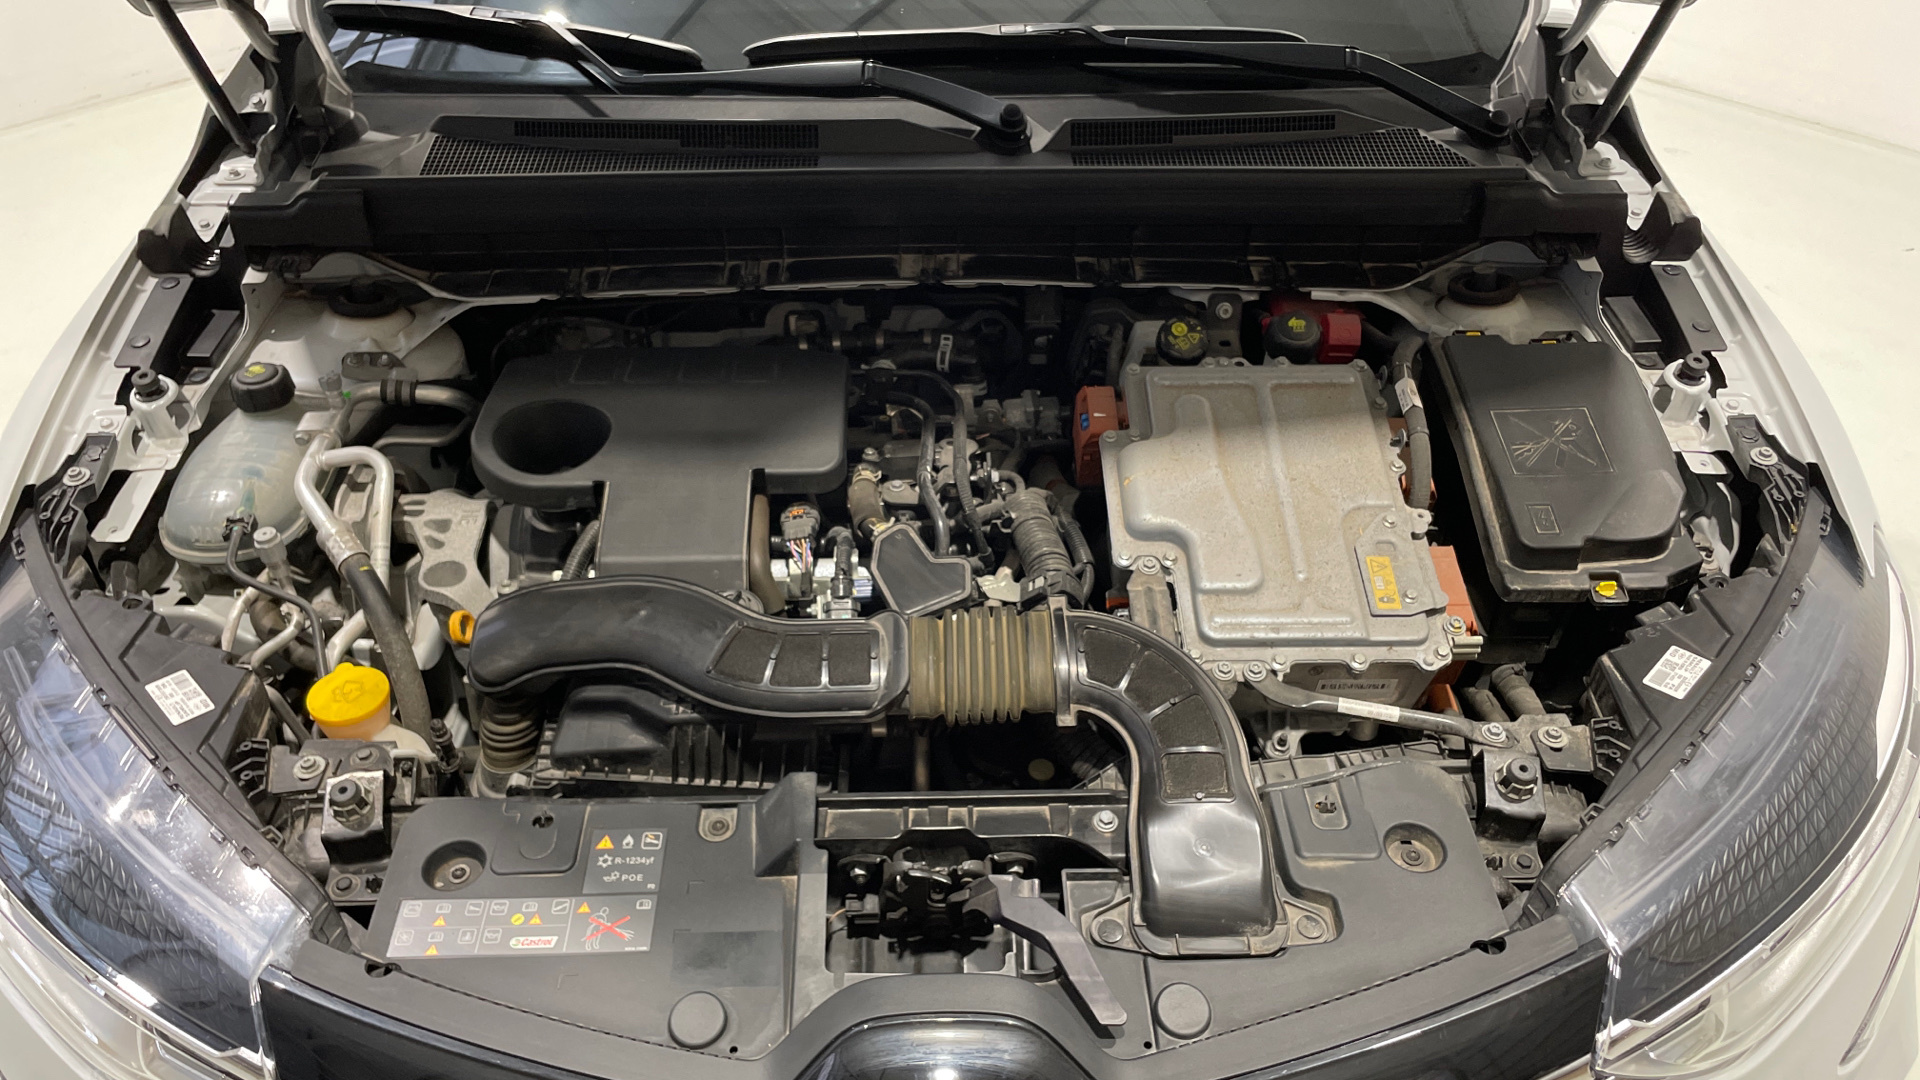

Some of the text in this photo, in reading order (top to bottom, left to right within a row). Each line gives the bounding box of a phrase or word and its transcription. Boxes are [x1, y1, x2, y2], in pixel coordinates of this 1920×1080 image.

[614, 856, 654, 866] R-1234yf
[621, 873, 643, 881] POE
[521, 937, 553, 947] Castrol
